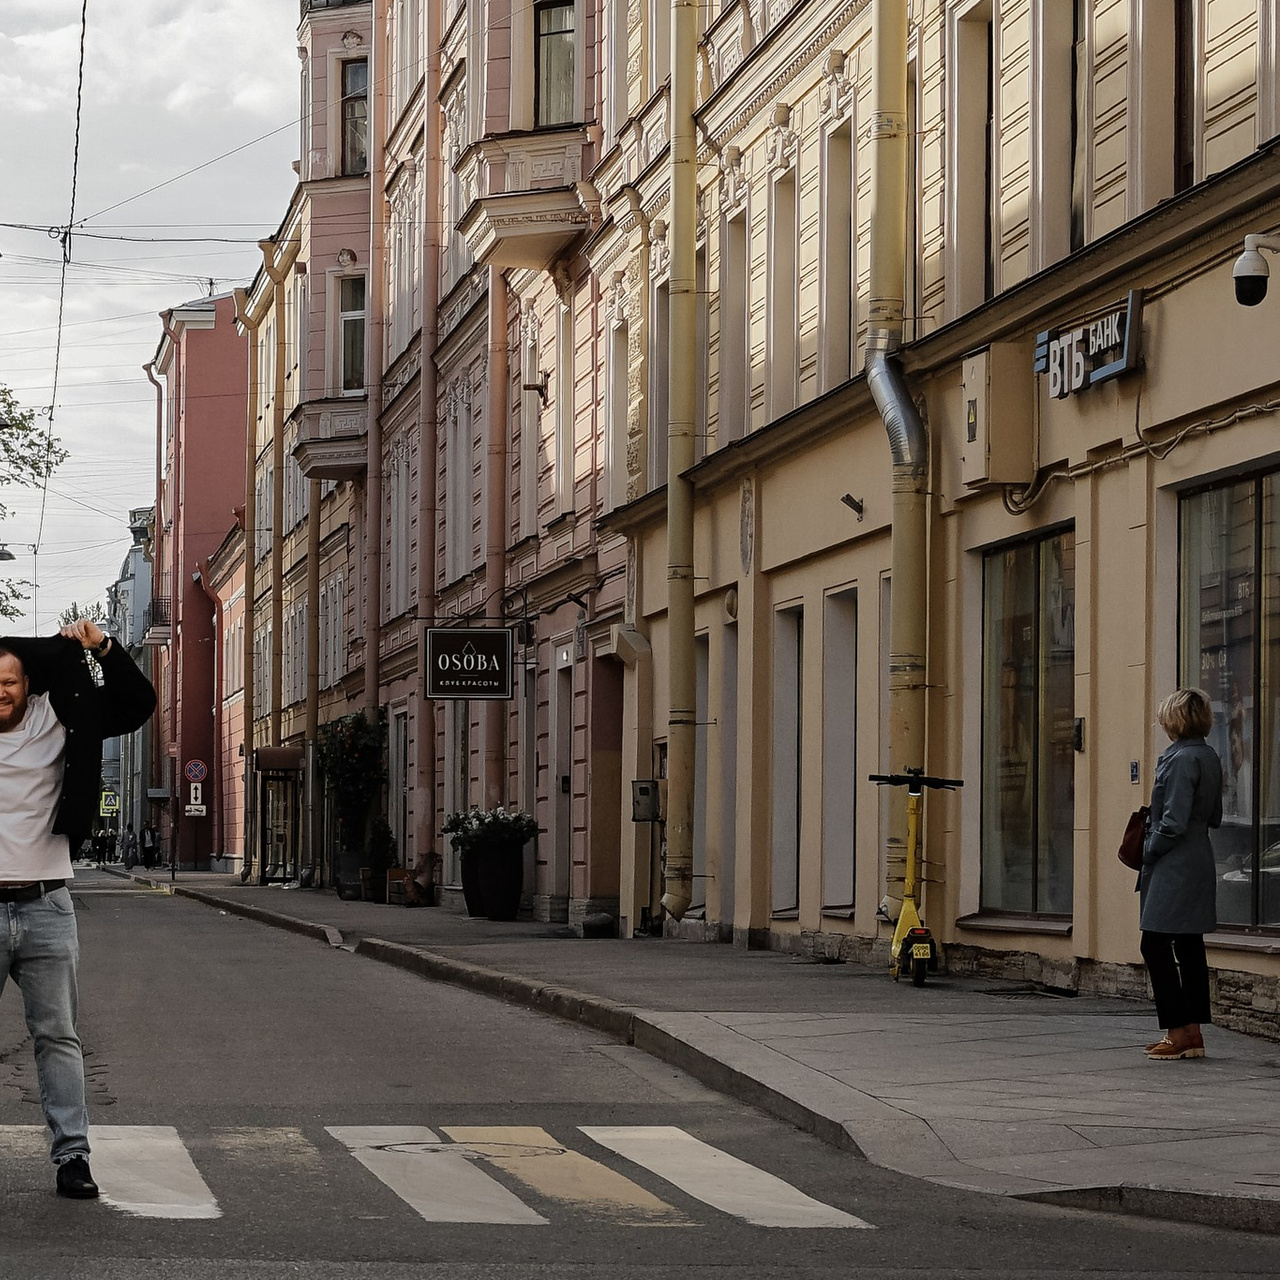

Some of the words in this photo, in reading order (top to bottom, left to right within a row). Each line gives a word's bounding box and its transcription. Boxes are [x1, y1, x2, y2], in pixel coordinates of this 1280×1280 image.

[1049, 328, 1085, 399] ВТБ
[1089, 311, 1121, 356] БАНК
[438, 653, 500, 671] OSOBA
